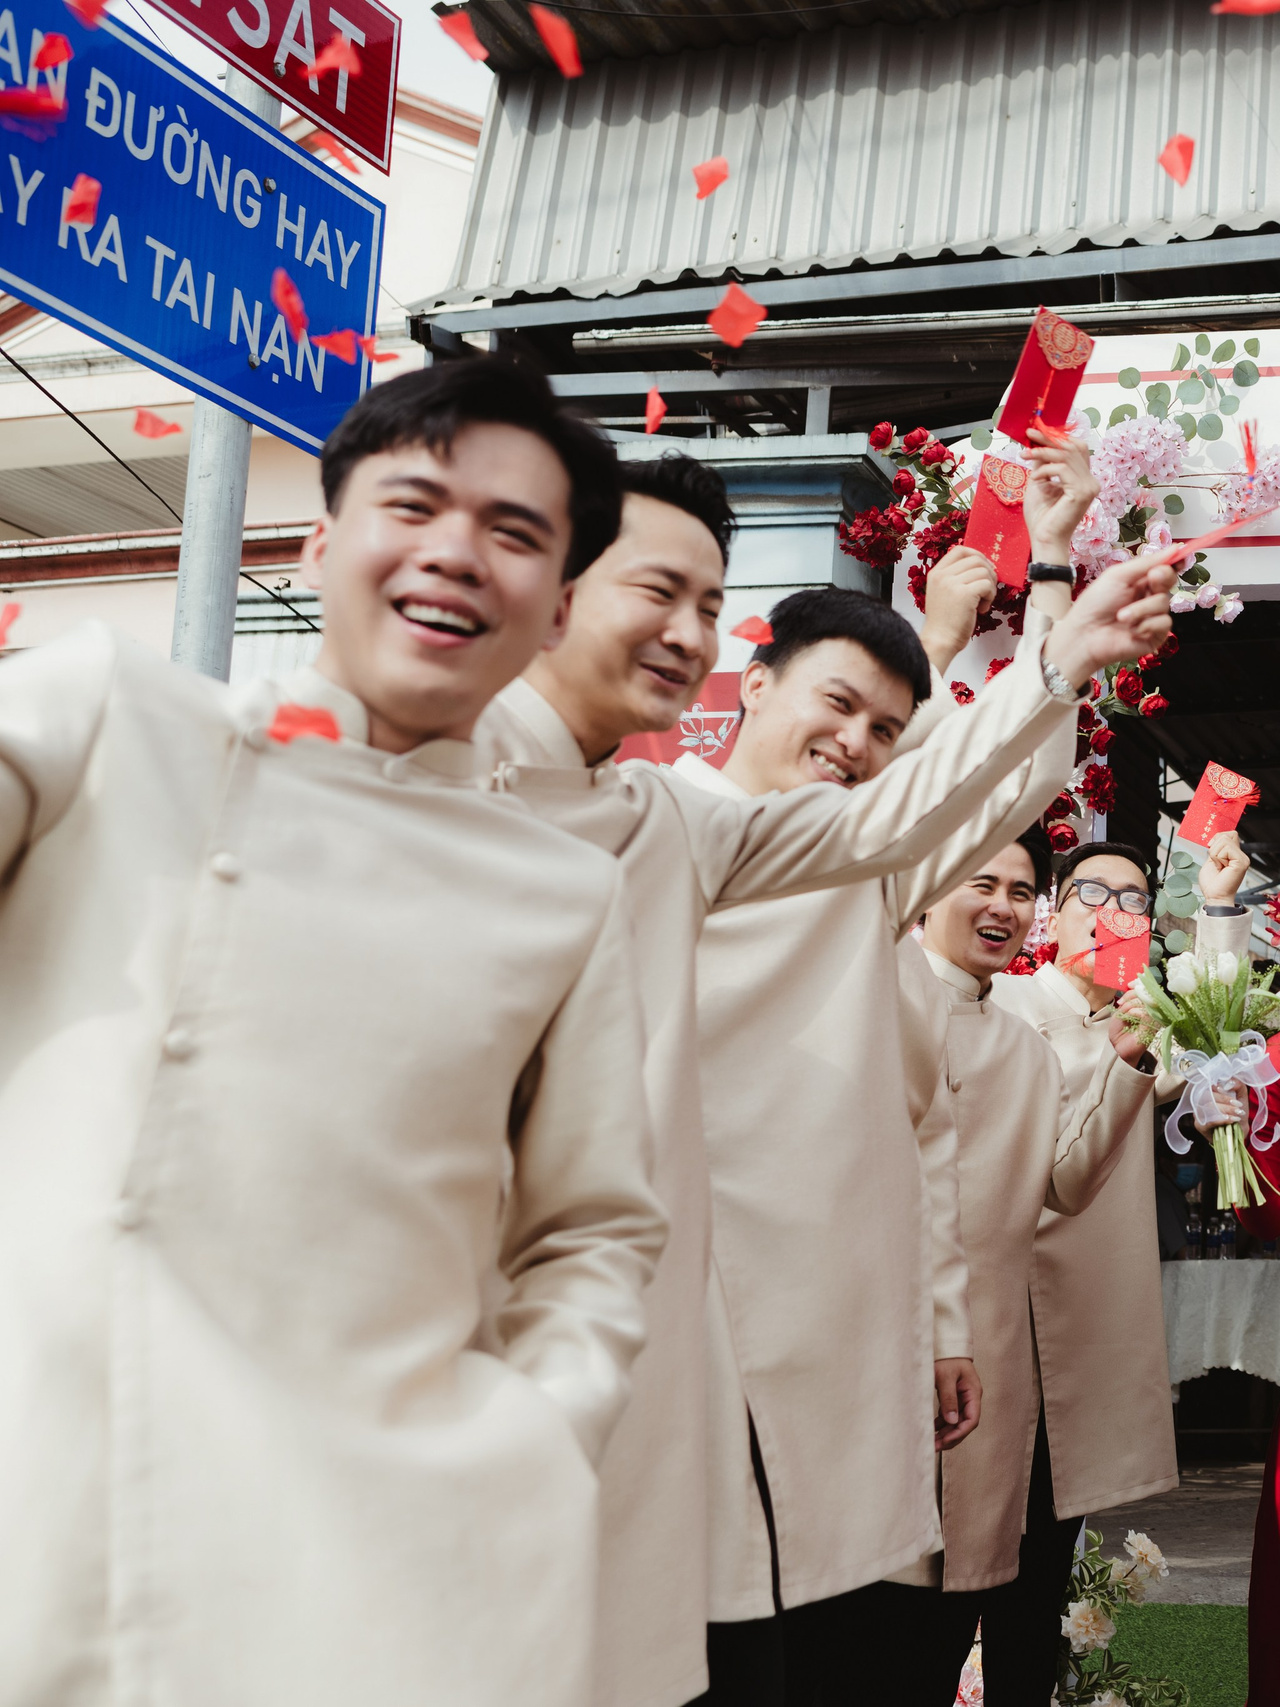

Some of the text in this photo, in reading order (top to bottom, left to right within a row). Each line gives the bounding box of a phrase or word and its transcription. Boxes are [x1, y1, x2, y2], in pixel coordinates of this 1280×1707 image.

[85, 66, 263, 229] ĐƯỜNG
[276, 193, 361, 290] HAY
[145, 235, 216, 330] TAI
[229, 287, 326, 394] NẠN
[990, 531, 1005, 562] 百年好
